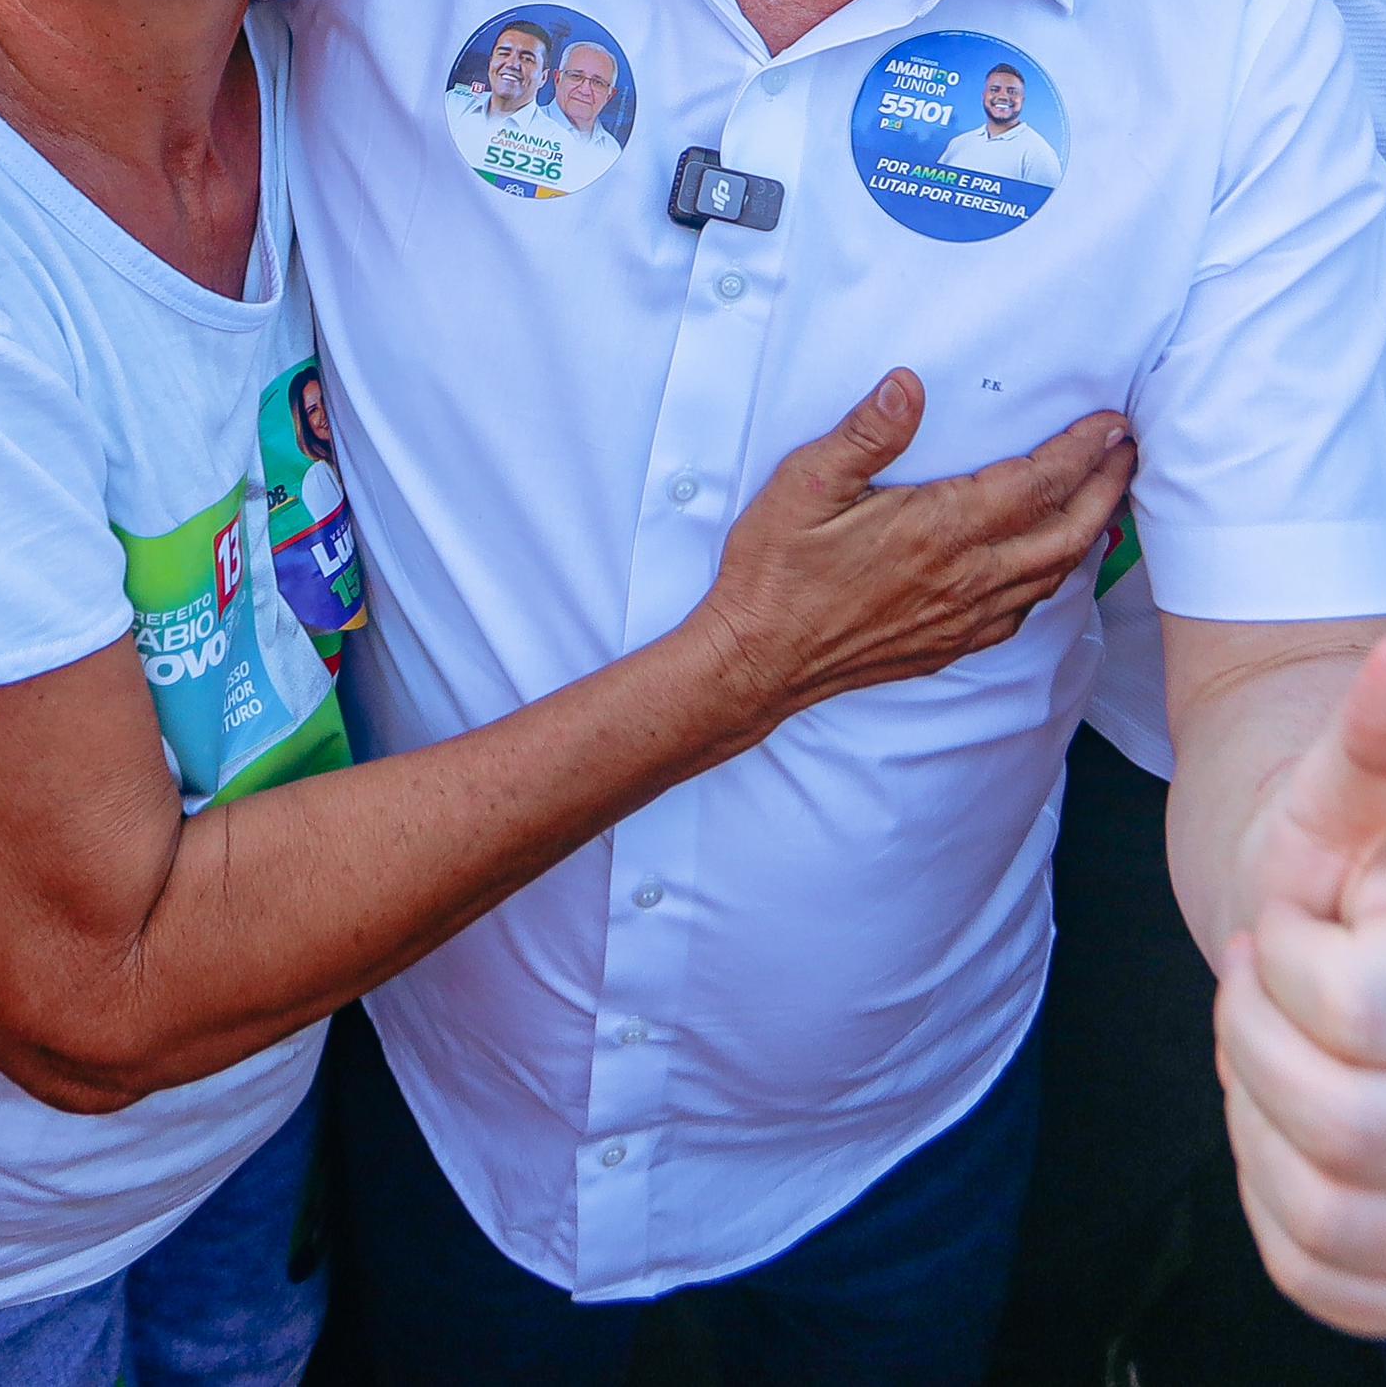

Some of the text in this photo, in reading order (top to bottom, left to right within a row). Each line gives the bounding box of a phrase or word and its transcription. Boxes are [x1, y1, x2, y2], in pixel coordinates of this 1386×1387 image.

[877, 92, 954, 126] 55101
[498, 128, 561, 152] ANANIAS
[484, 144, 563, 180] 55236
[876, 158, 1002, 195] POR AMAR E PRA
[869, 175, 1030, 220] LUTAR POR TERESINA.
[218, 521, 242, 597] 13
[140, 629, 227, 686] OVO
[221, 698, 264, 735] TURO
